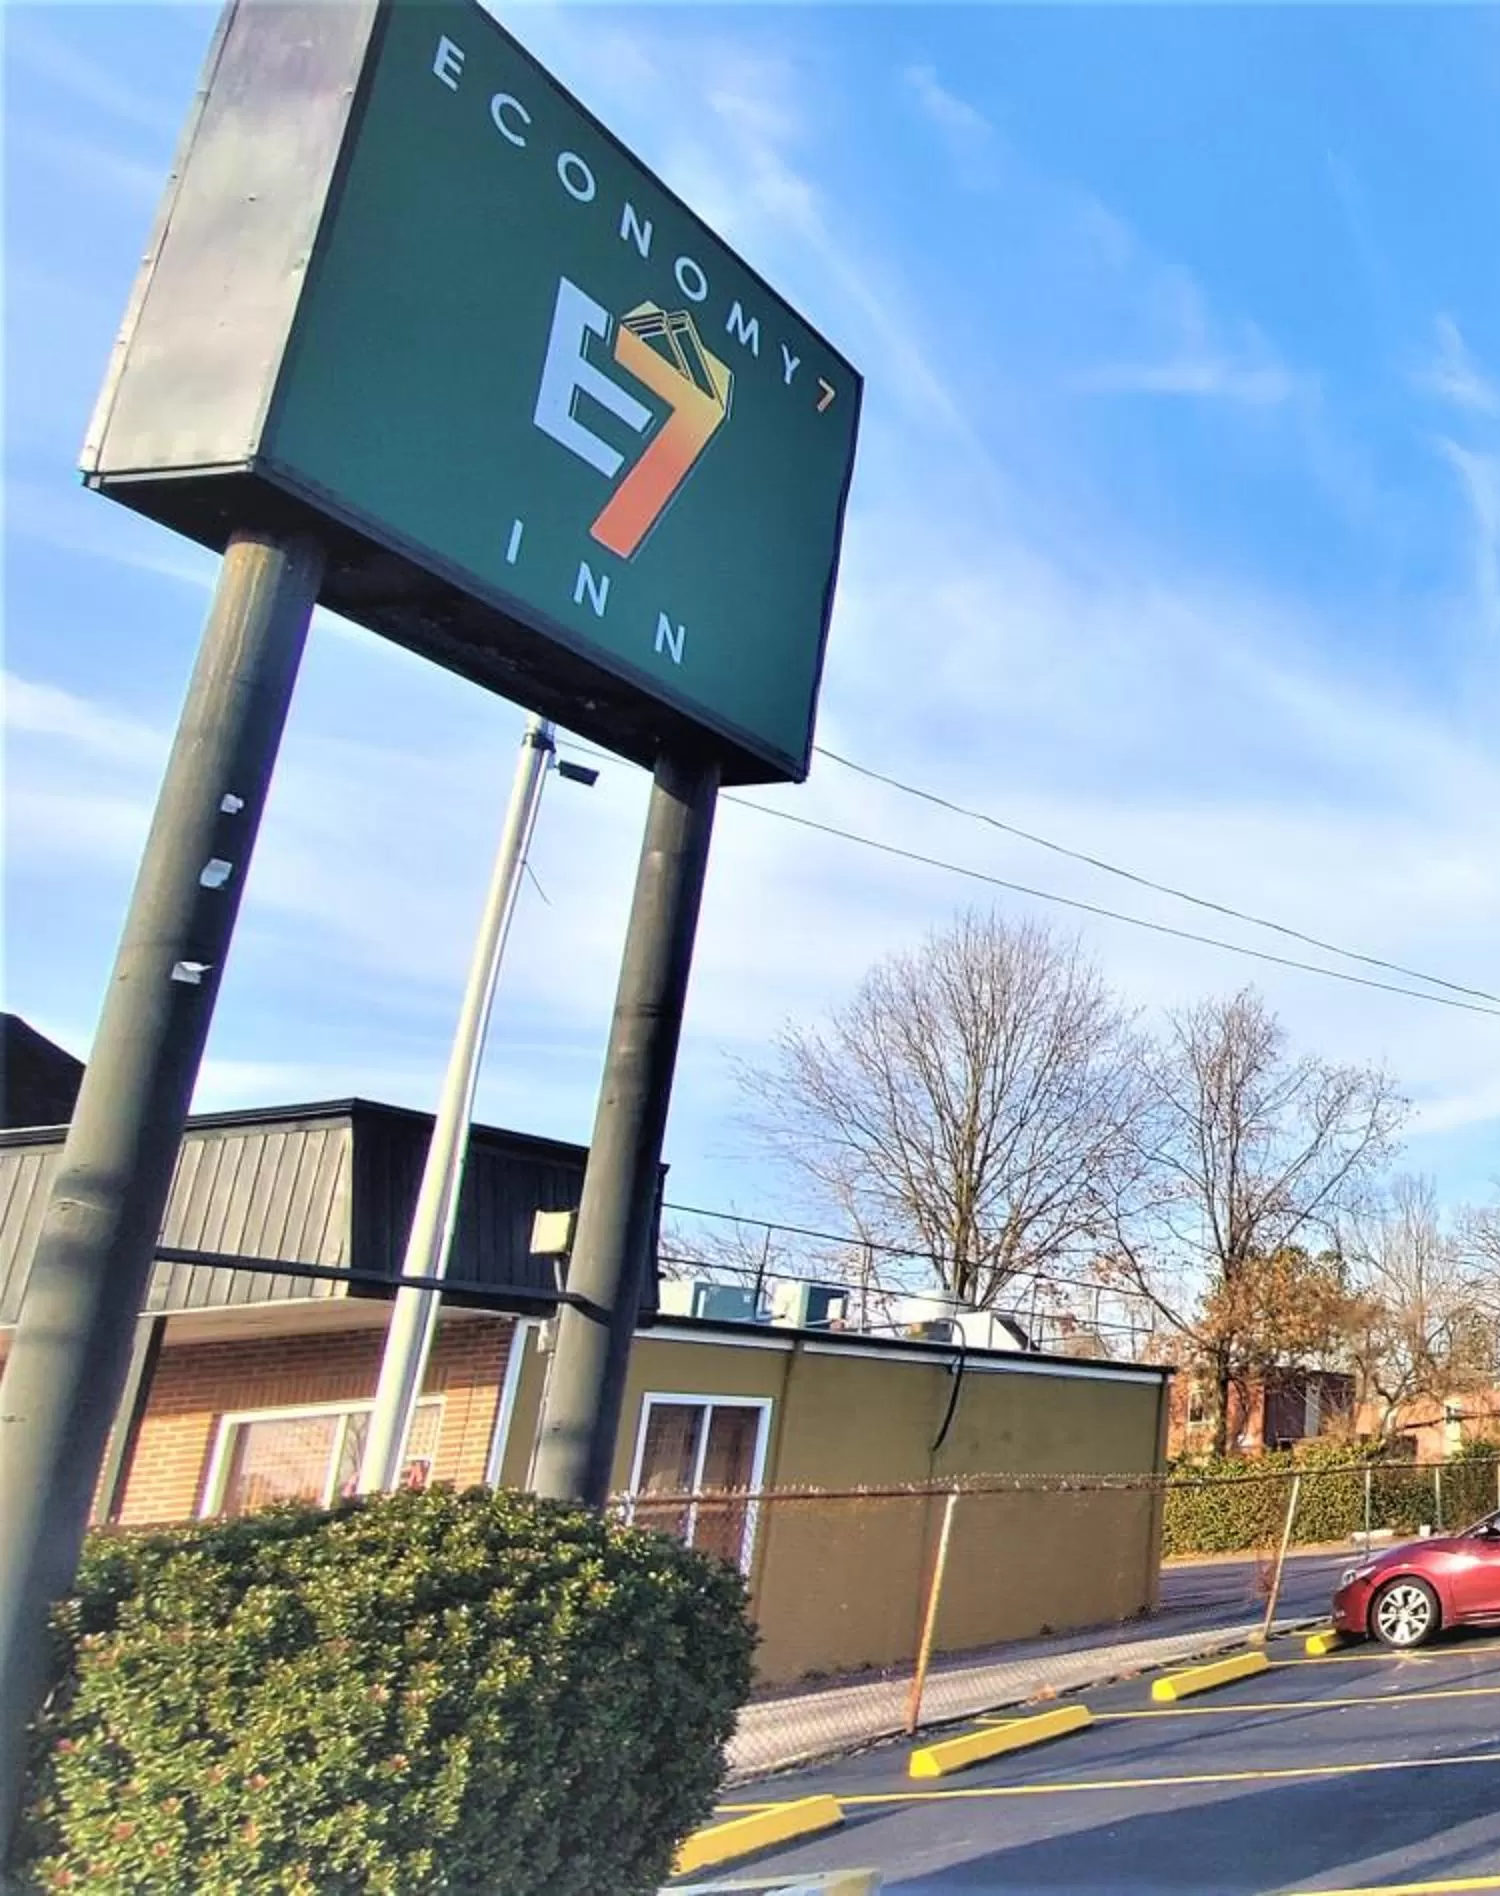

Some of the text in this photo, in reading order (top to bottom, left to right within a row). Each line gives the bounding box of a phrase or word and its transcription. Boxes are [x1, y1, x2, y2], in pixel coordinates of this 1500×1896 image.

[433, 35, 836, 411] ECONOMY 7
[504, 519, 685, 664] INN
